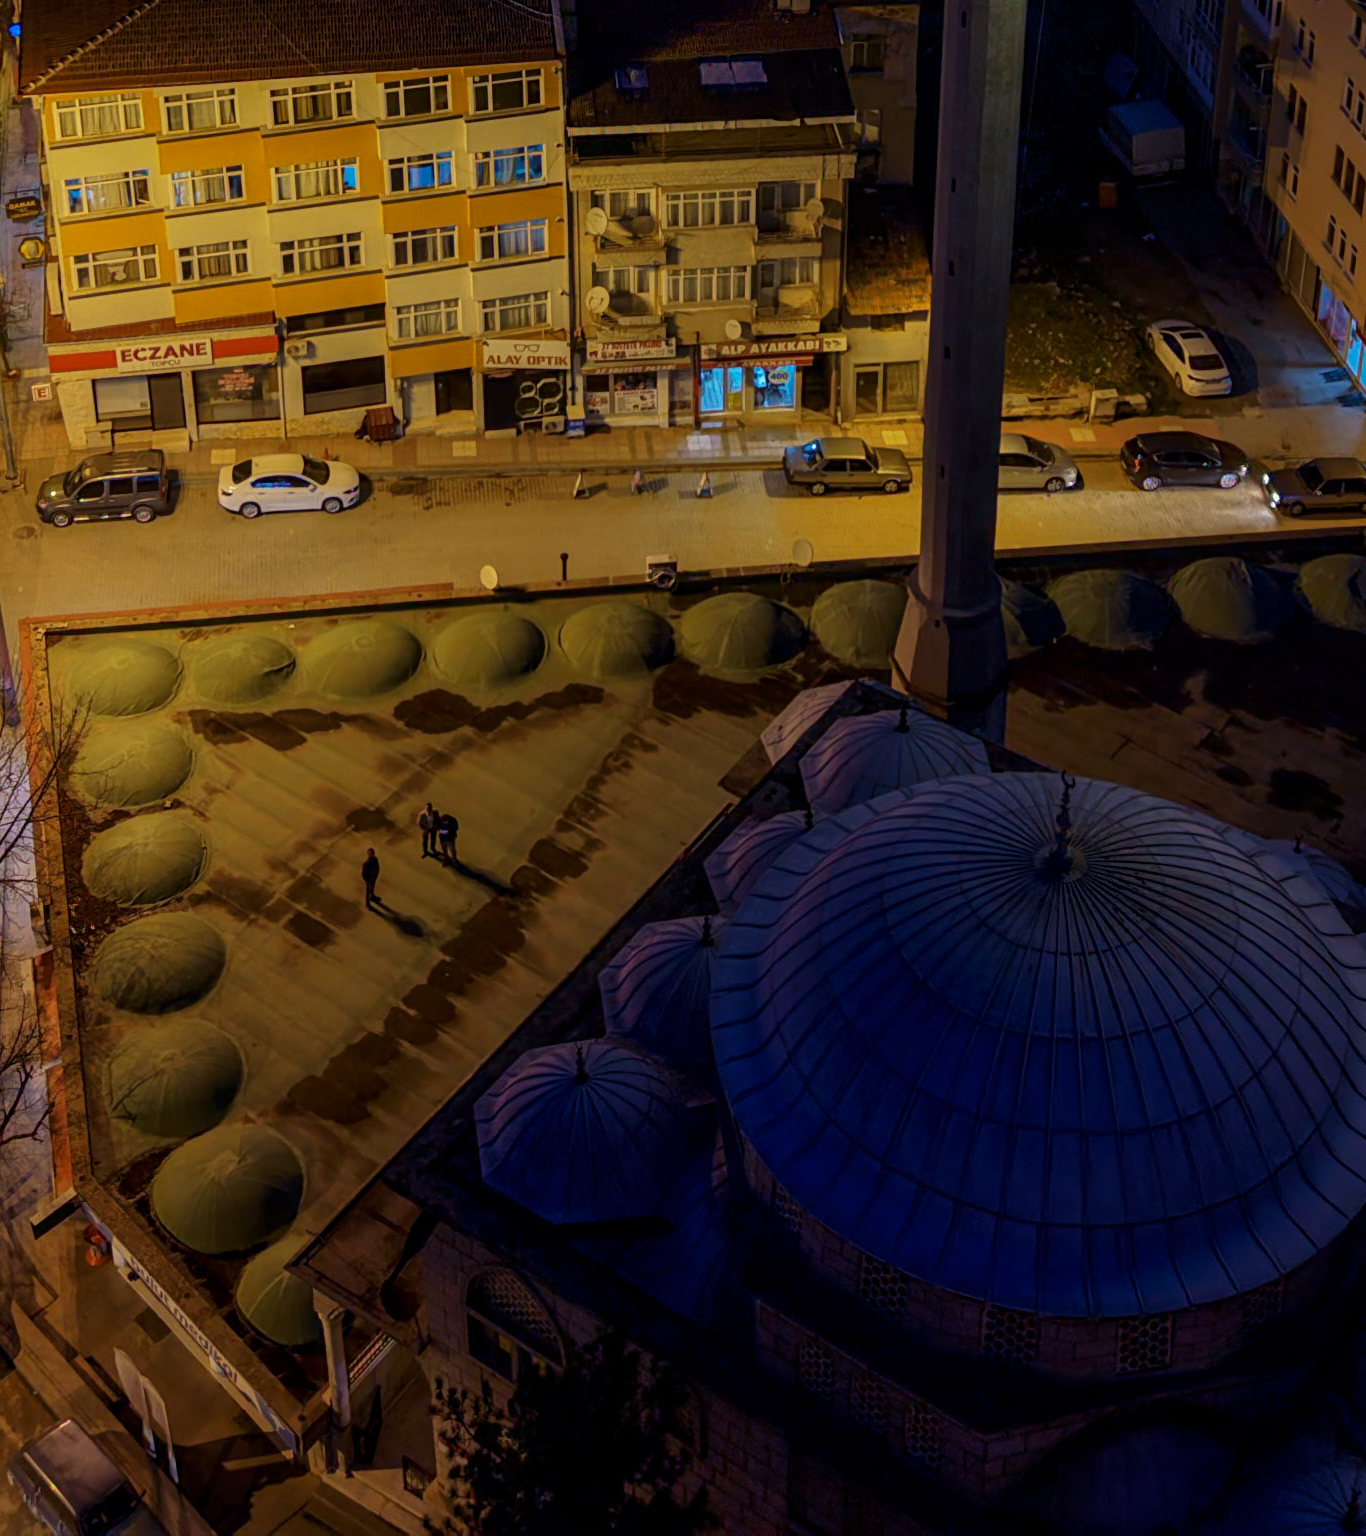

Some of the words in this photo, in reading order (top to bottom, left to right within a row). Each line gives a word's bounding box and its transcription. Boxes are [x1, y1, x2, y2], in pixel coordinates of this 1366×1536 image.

[120, 341, 208, 363] ECZANE
[721, 344, 746, 354] ALP
[750, 340, 819, 354] AYAKKABI
[486, 354, 523, 365] ALAY
